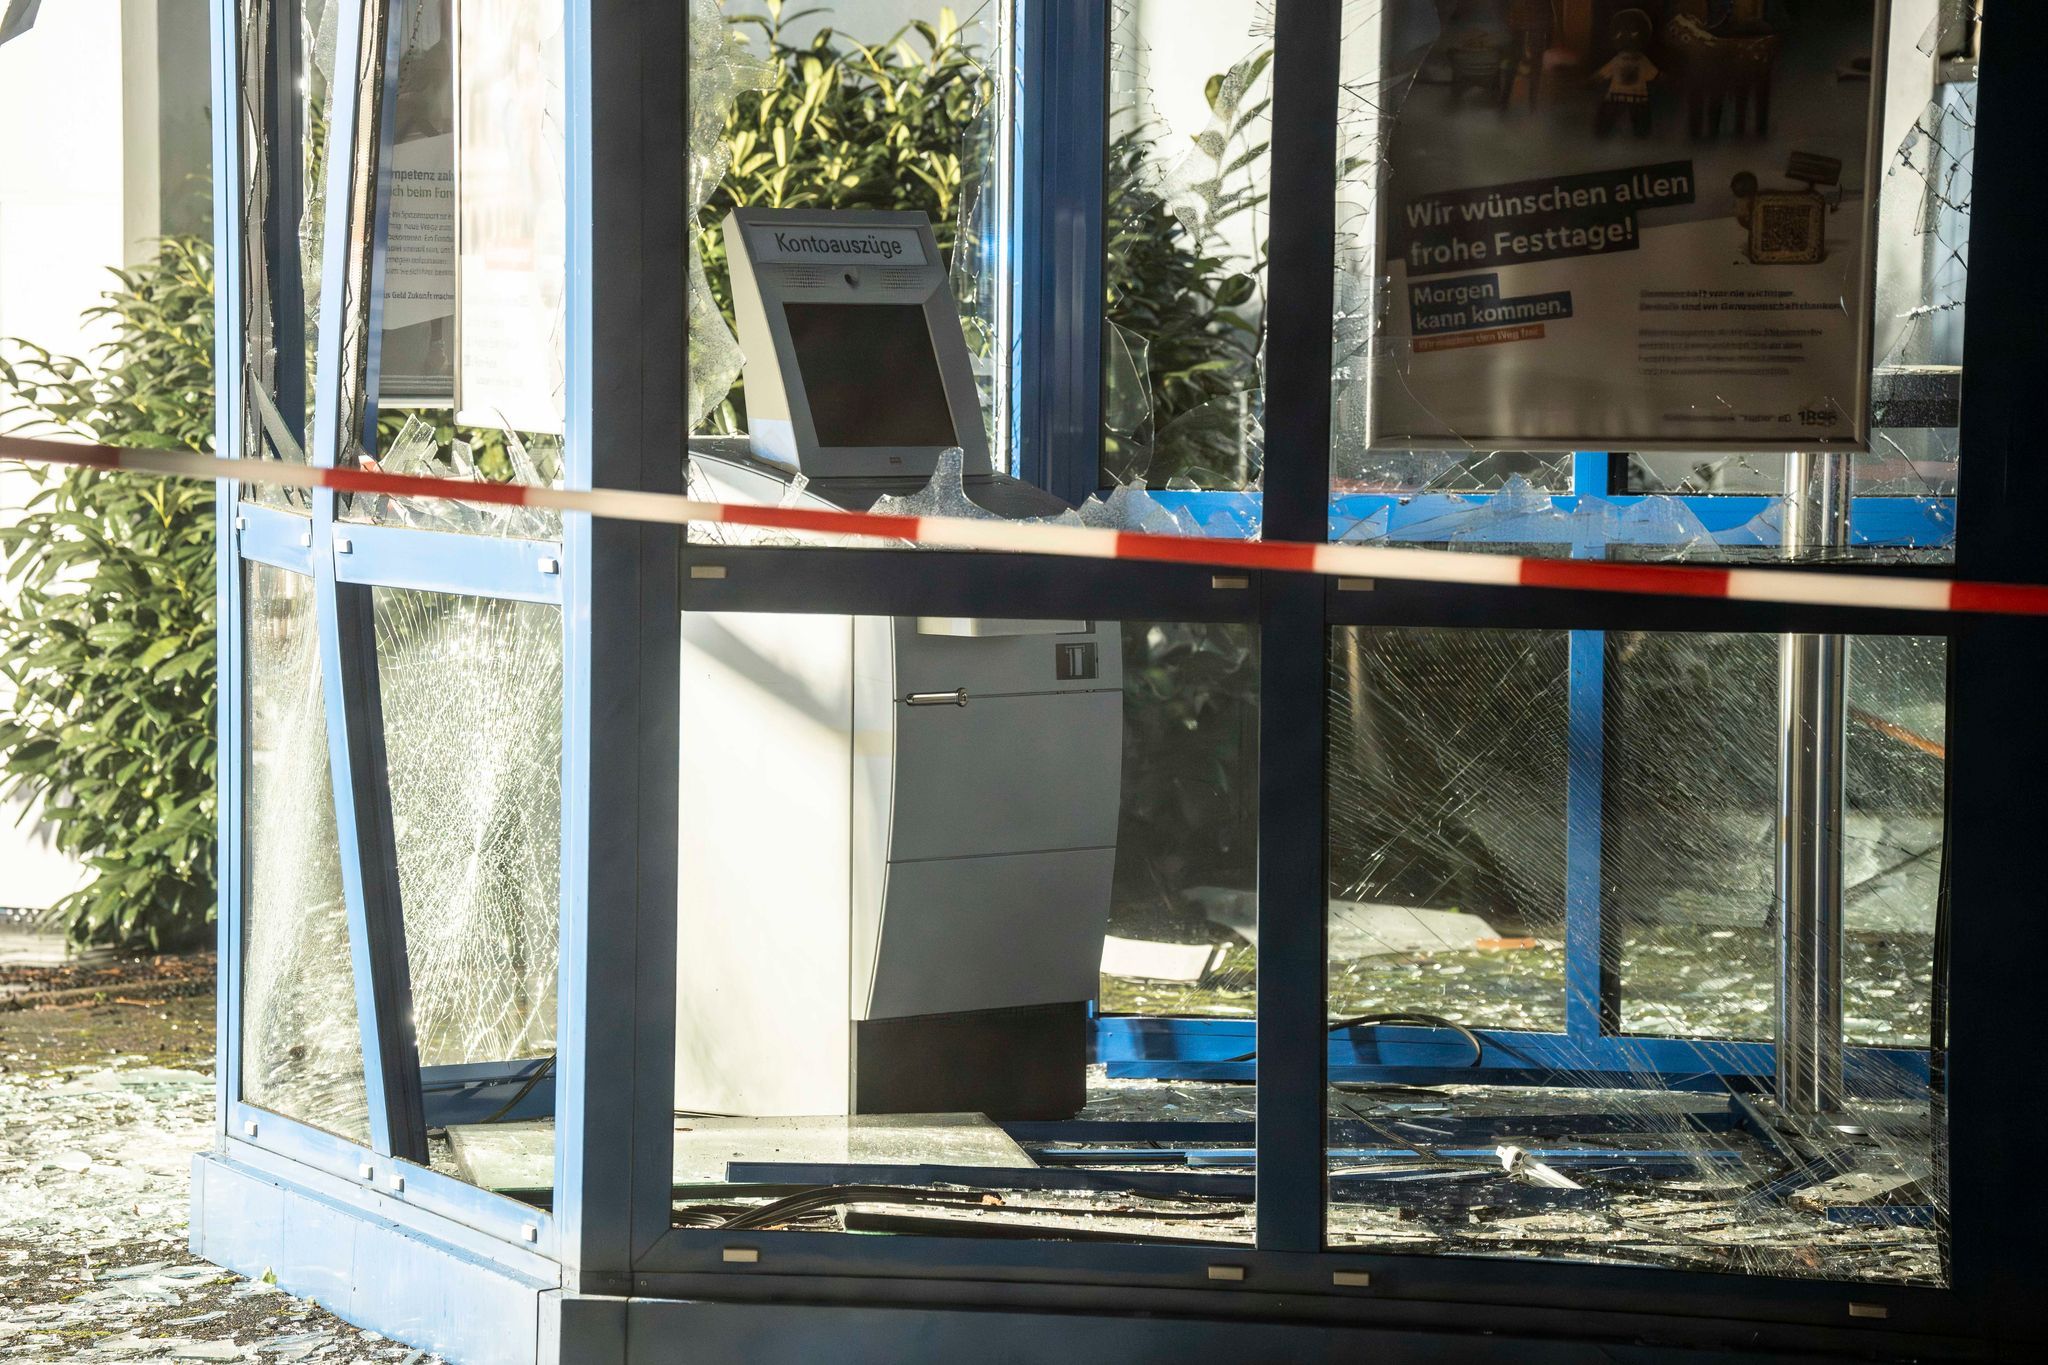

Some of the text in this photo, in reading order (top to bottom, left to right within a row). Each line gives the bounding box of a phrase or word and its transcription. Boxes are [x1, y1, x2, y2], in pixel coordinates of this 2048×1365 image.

[406, 185, 432, 198] beim
[1407, 174, 1689, 229] Wir wünschen allen
[775, 232, 903, 259] Kontoauszüge
[1411, 216, 1634, 267] frohe Festtage!
[1413, 283, 1494, 306] Morgen
[1416, 300, 1567, 330] kann kommen.
